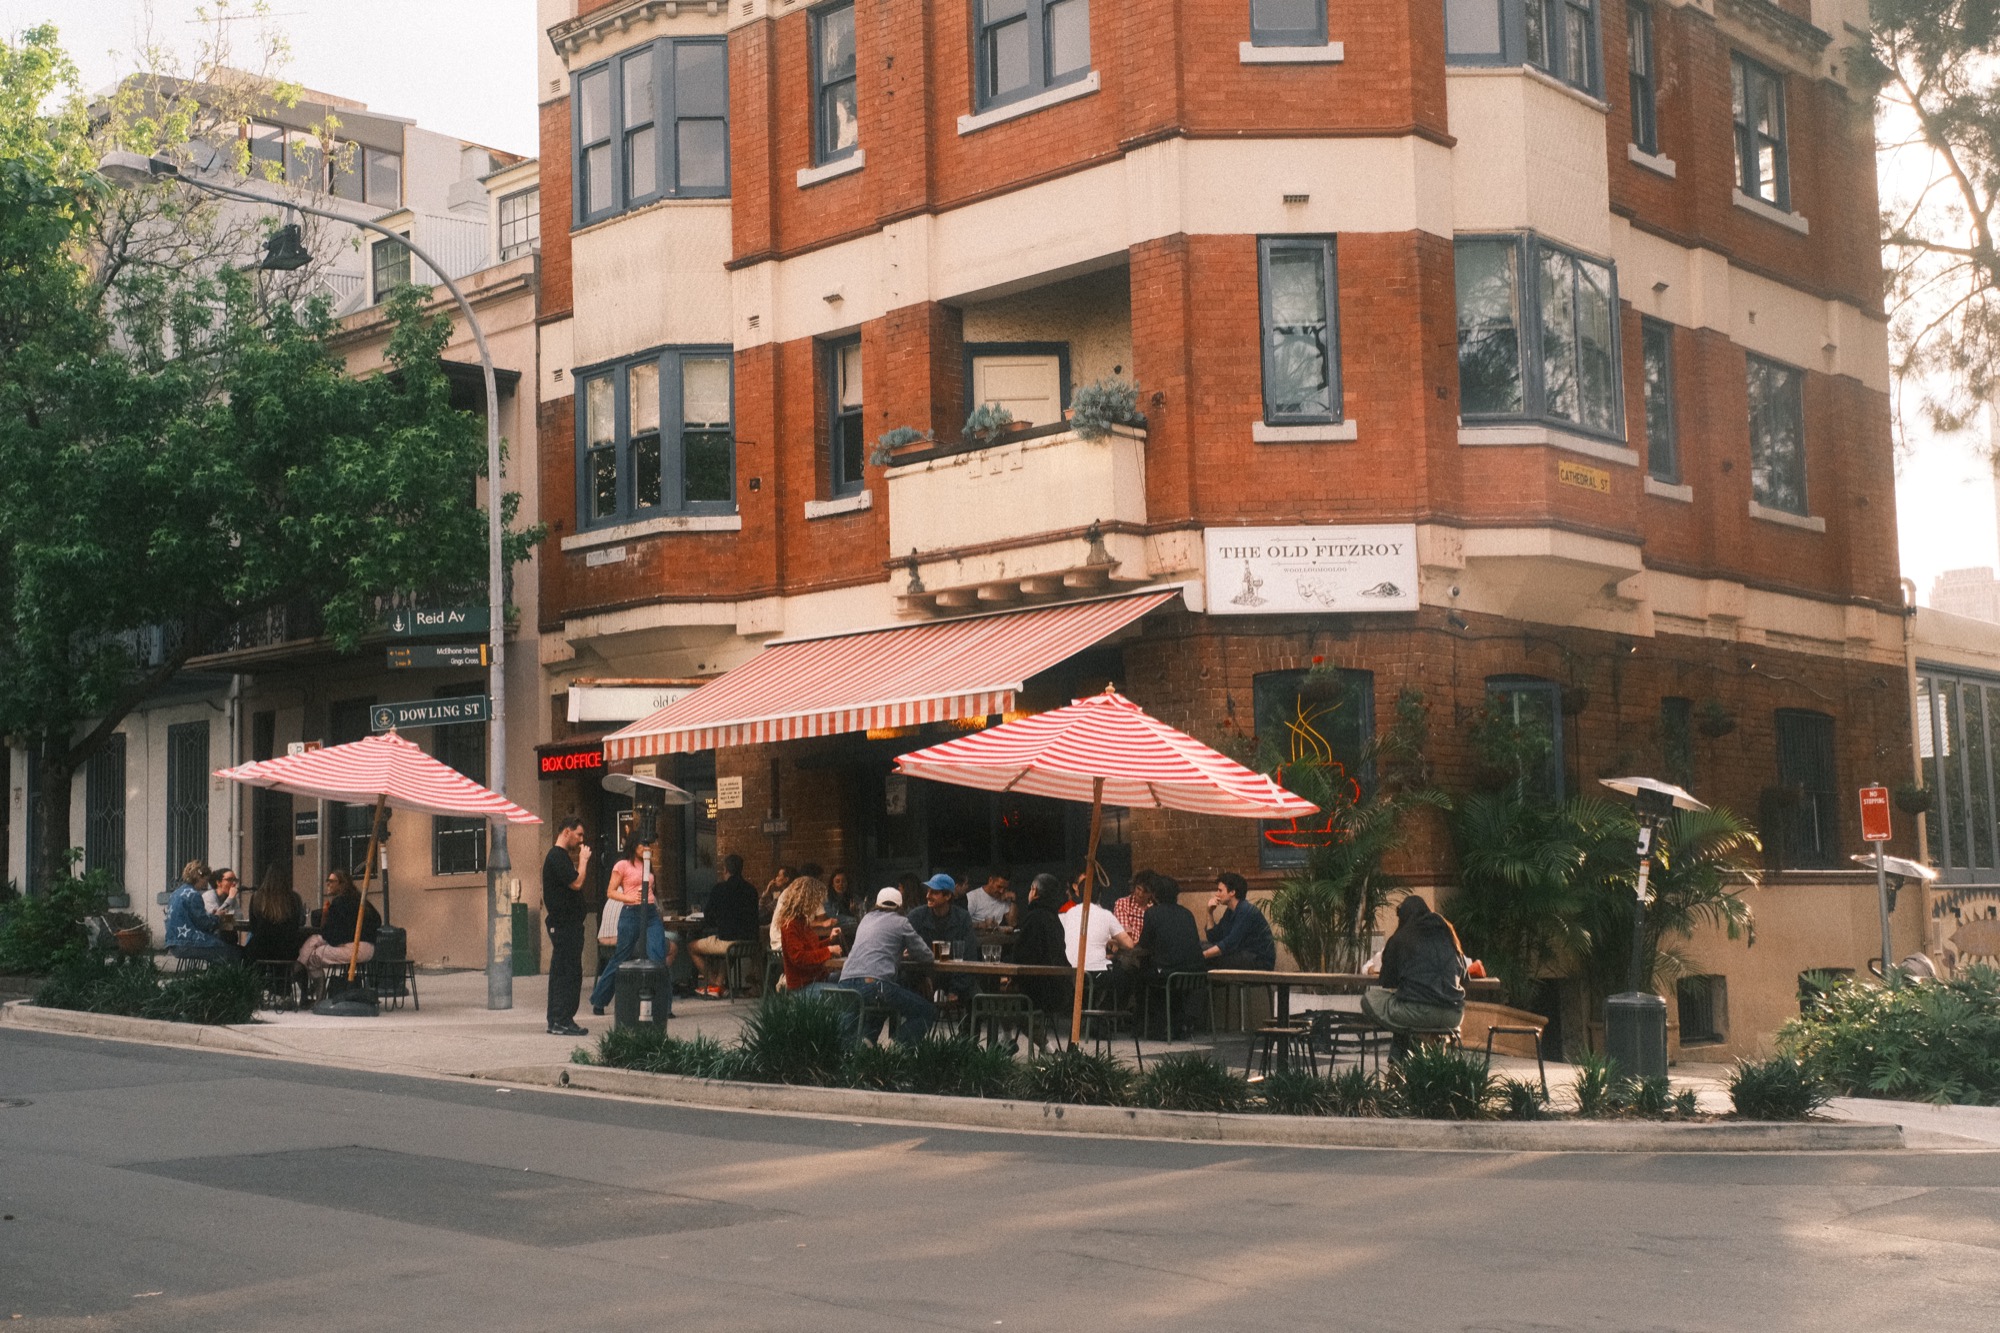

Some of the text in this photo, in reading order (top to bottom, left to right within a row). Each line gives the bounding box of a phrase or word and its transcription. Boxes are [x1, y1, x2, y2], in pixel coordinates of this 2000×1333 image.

[1560, 469, 1597, 489] CATHEDRAL
[1219, 543, 1403, 559] THE OLD FITZROY
[416, 610, 465, 625] Reid Av
[436, 647, 462, 655] McElhone
[465, 657, 479, 665] Cross
[652, 695, 669, 708] old
[399, 703, 479, 722] DOWLING ST
[542, 756, 564, 772] BOX
[565, 752, 602, 770] OFFICE
